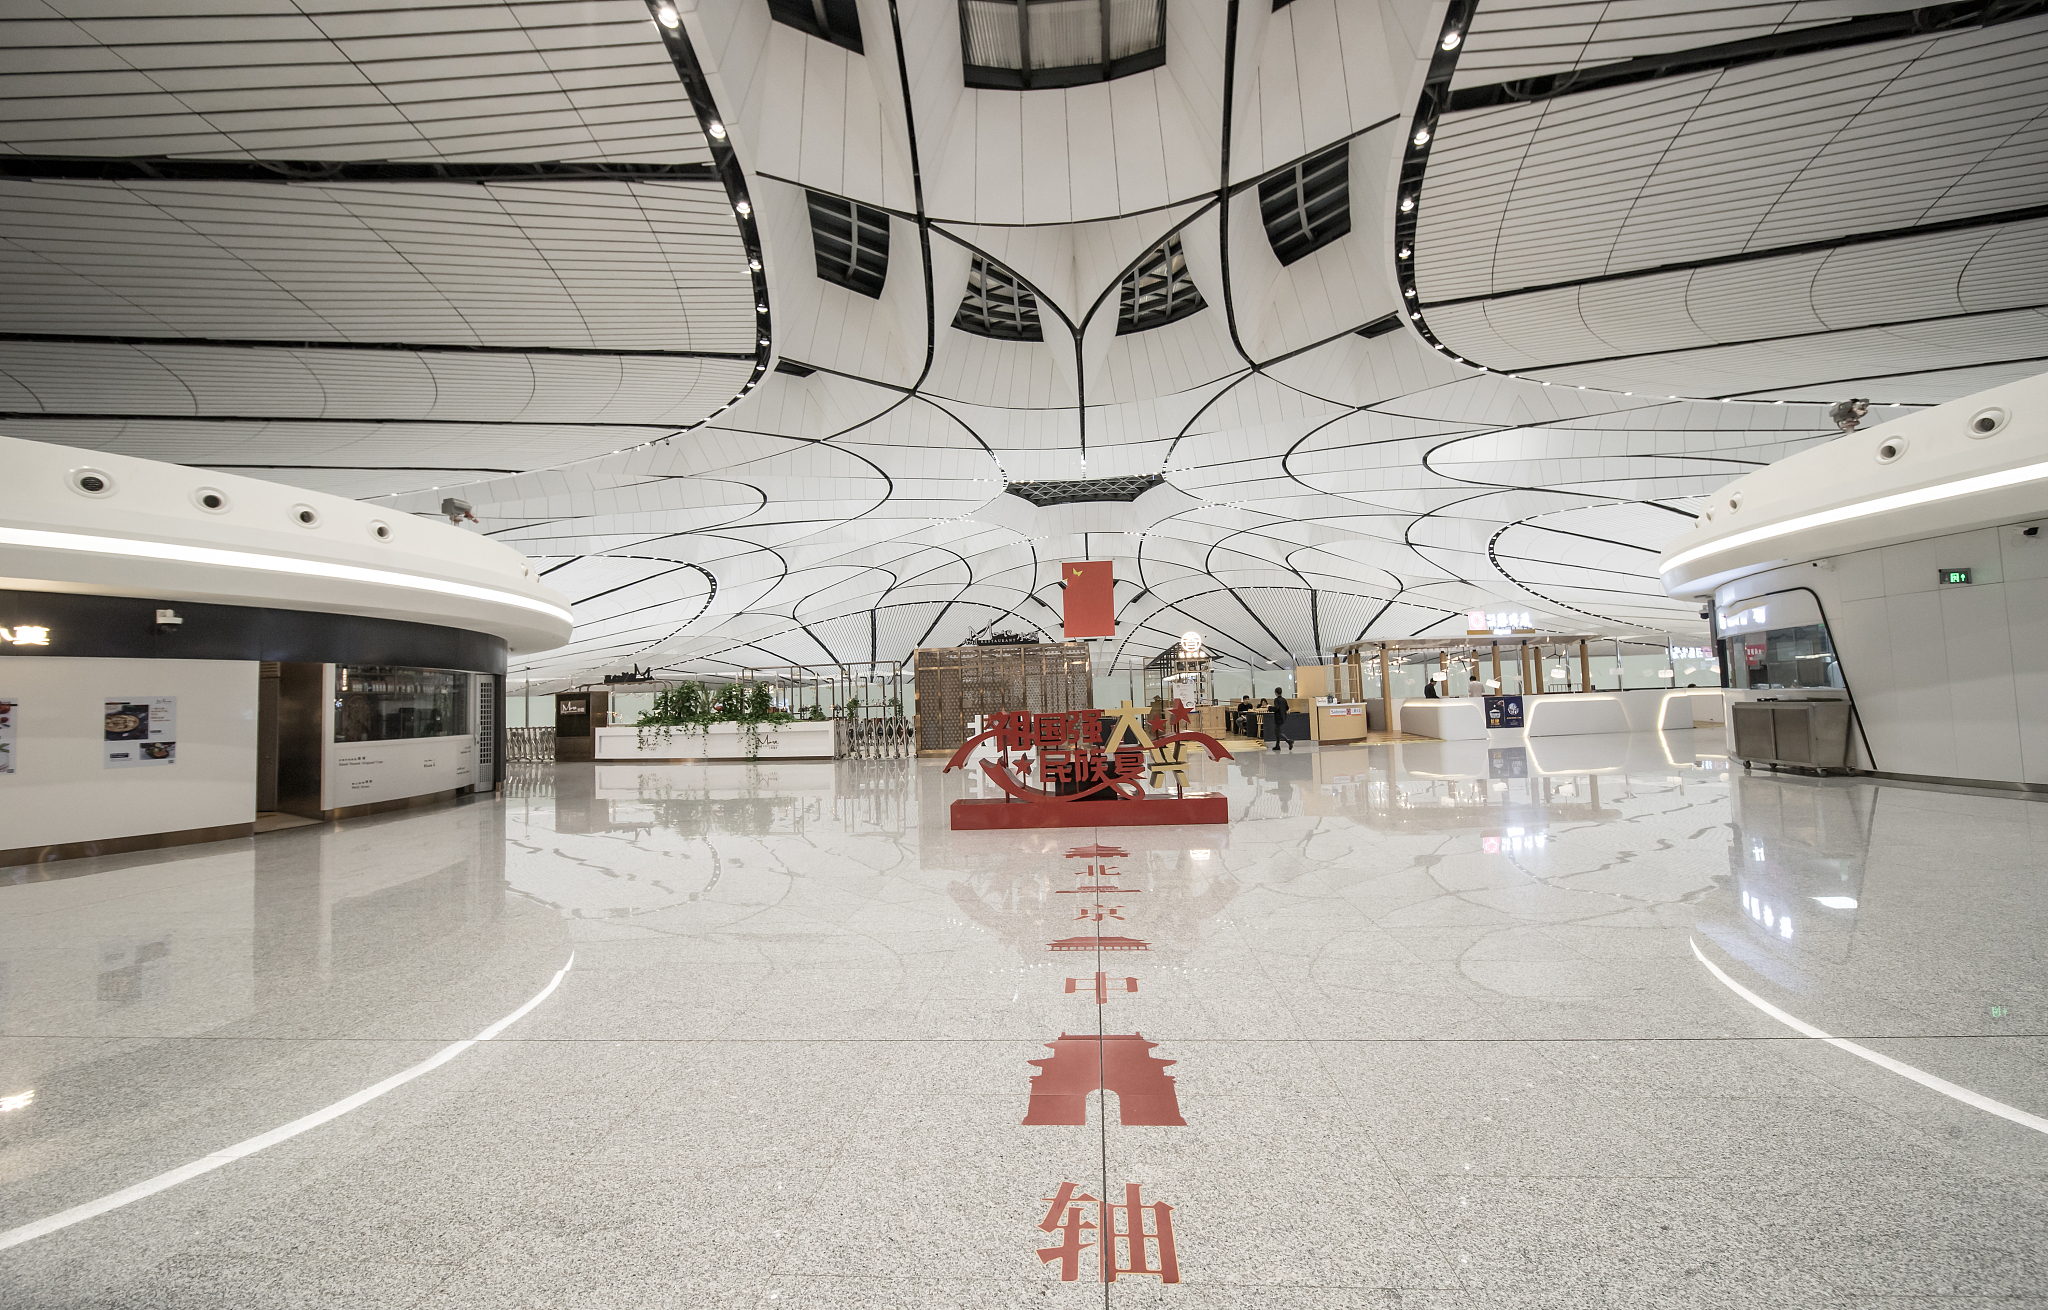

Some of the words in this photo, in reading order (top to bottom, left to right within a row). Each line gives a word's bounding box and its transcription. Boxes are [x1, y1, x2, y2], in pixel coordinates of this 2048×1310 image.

[1074, 865, 1121, 876] 北
[1072, 904, 1125, 921] 京
[1064, 971, 1139, 1004] 中
[1036, 1181, 1181, 1284] 轴
